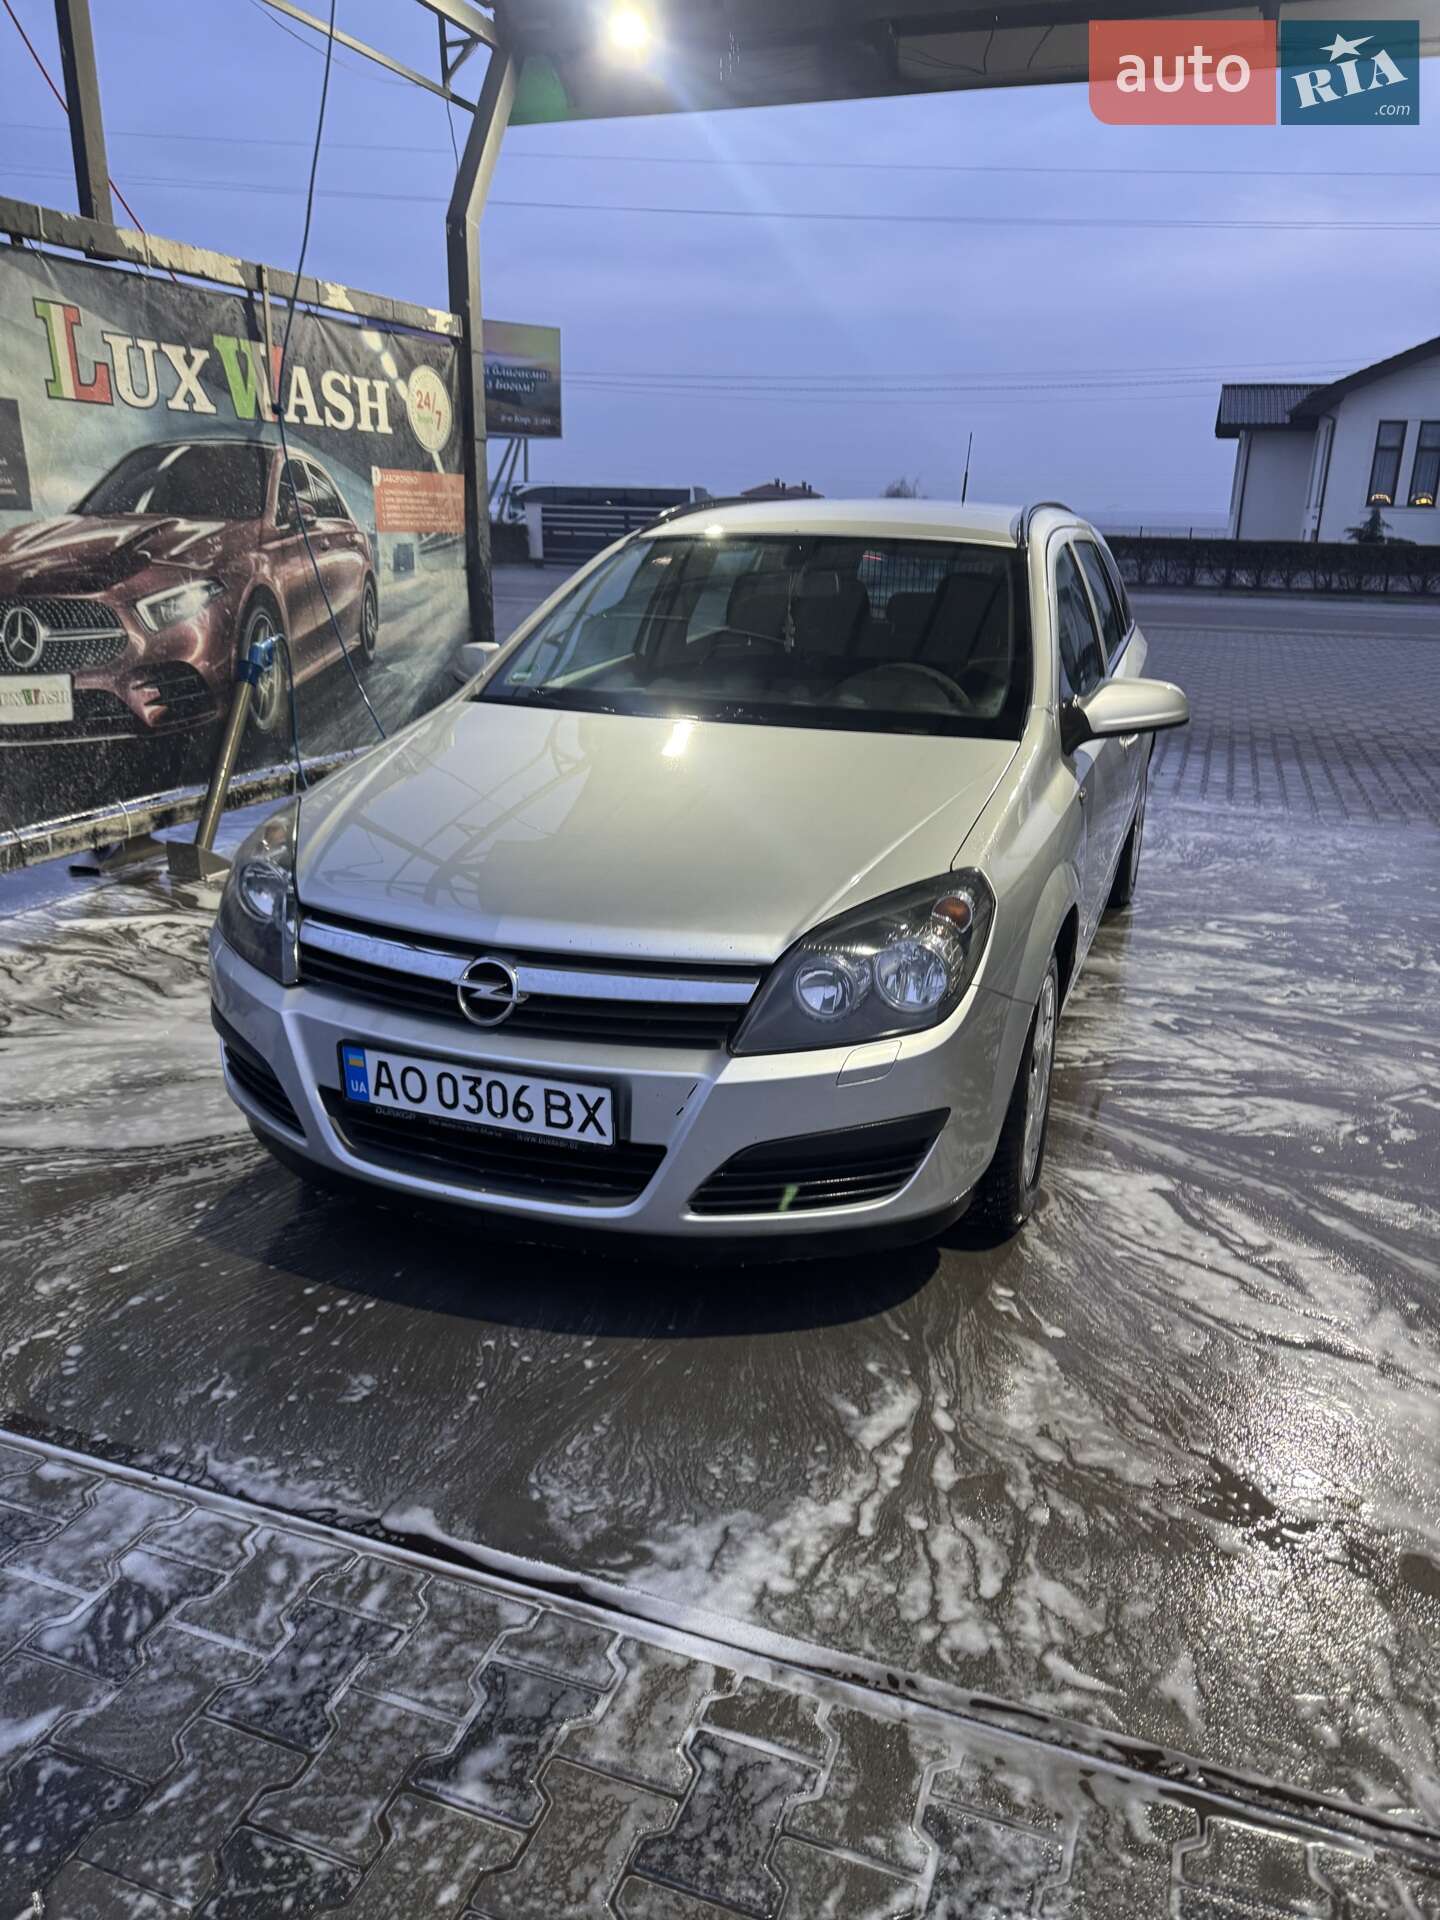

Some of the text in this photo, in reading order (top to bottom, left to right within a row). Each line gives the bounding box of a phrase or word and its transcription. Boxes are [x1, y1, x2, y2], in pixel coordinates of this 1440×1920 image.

[416, 389, 442, 431] 24/7
[350, 1079, 367, 1094] UA
[373, 1060, 606, 1136] AO 0306 BX
